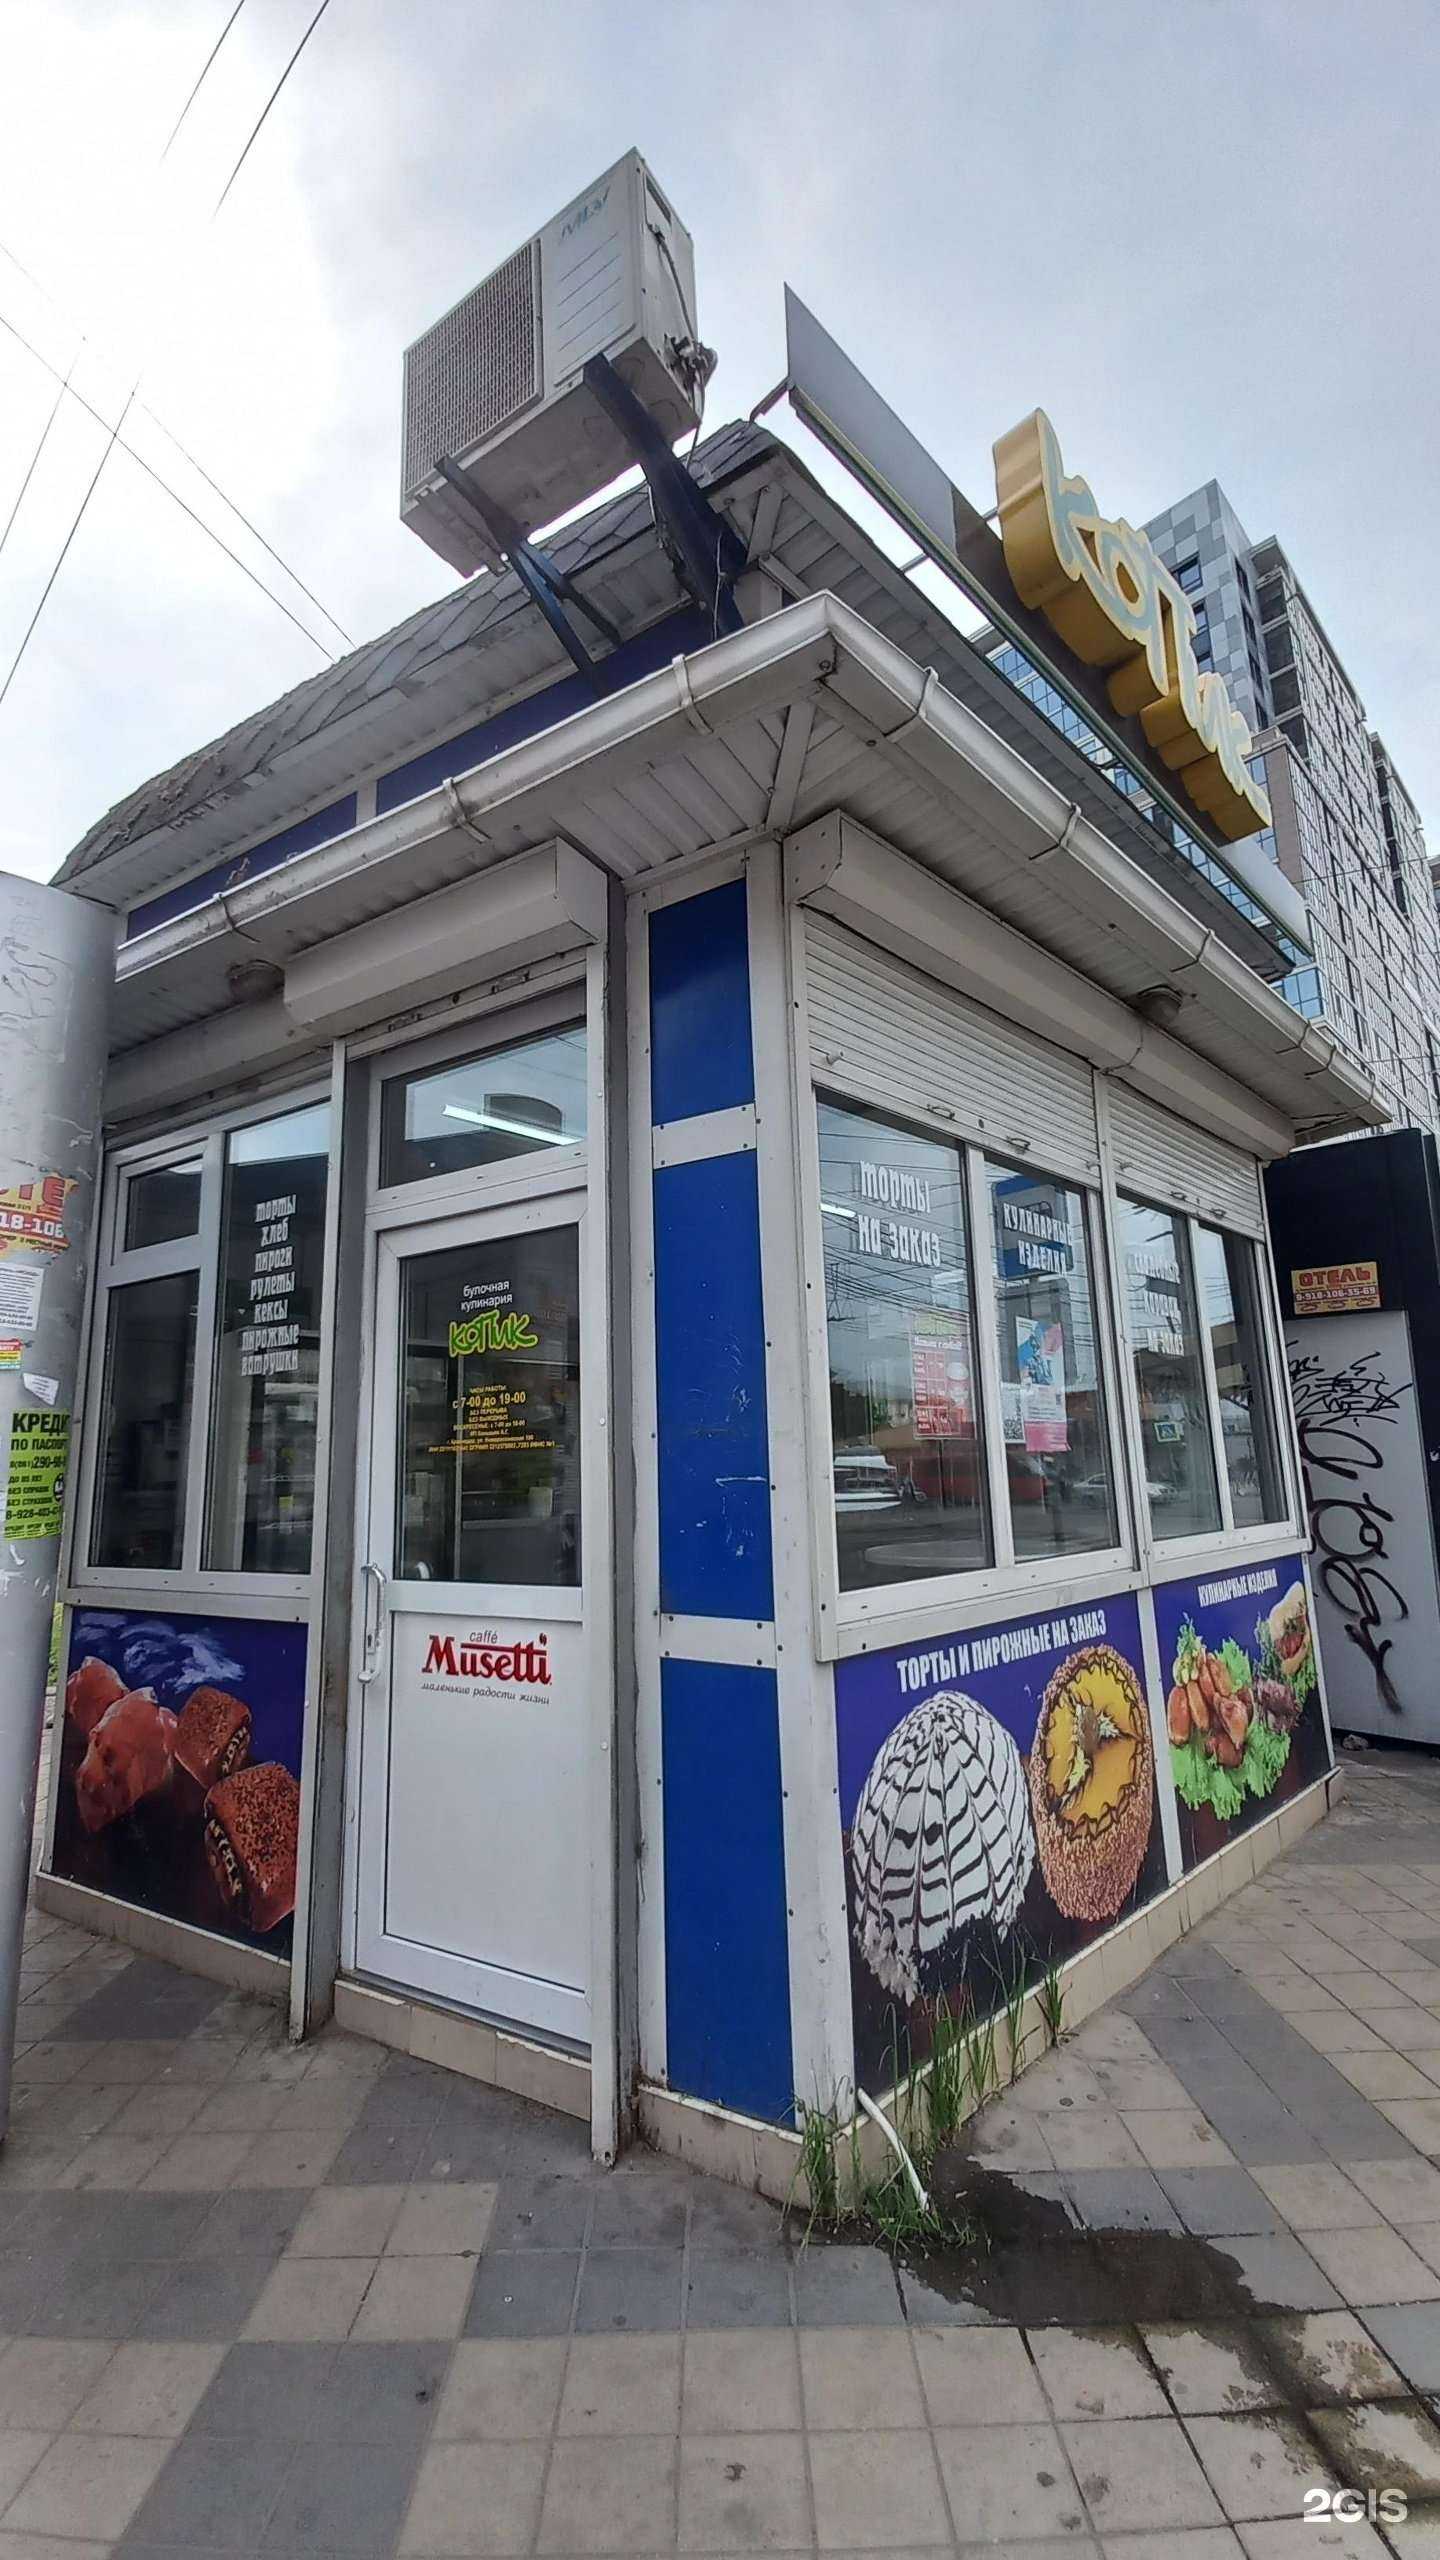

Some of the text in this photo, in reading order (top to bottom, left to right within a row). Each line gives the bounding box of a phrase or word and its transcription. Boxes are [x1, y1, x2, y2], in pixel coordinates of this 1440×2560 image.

[261, 1216, 289, 1247] хлеб
[1299, 1267, 1371, 1287] ОТЕЛЬ
[463, 1281, 510, 1299] булочная
[461, 1294, 513, 1312] кулинария
[460, 1396, 480, 1408] 7-00
[482, 1397, 497, 1408] до
[499, 1391, 526, 1405] 19-00
[11, 1439, 28, 1450] ПО
[422, 1633, 552, 1686] Musetti
[897, 1609, 1107, 1693] ТОРТЫ И ПИРОЖНЫЕ НА ЗАКАЗ
[473, 1686, 516, 1700] радости
